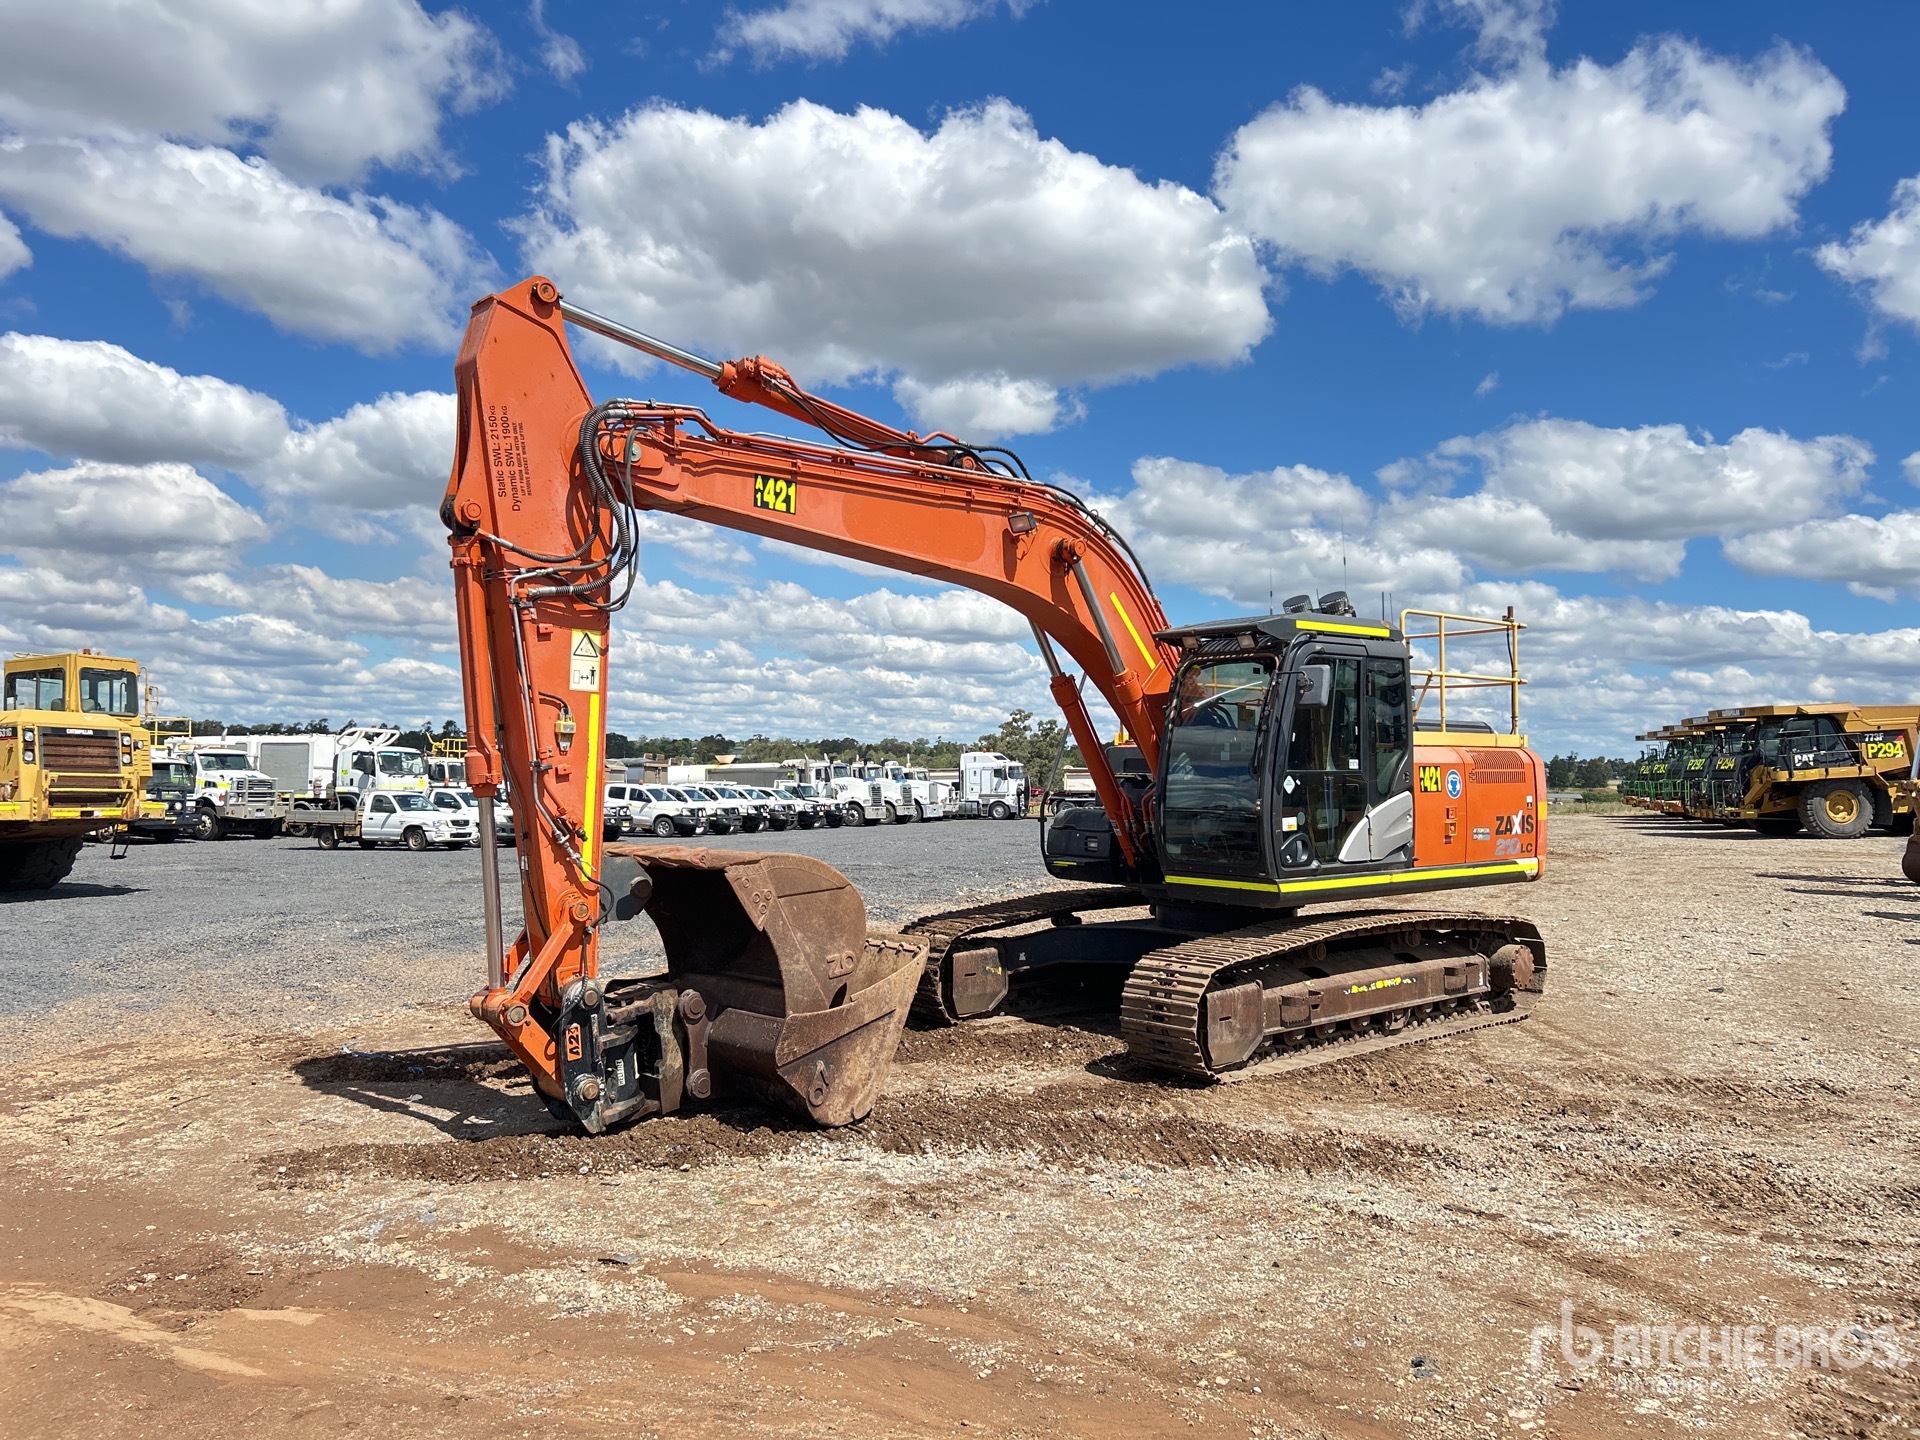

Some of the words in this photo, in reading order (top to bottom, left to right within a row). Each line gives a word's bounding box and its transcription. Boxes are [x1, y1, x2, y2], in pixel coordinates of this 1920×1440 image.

[492, 442, 503, 467] SWL:
[504, 442, 515, 467] SWL:
[496, 470, 506, 497] Static
[508, 470, 522, 511] Dynamic
[1864, 732, 1884, 742] 773F
[1794, 754, 1815, 767] CAT
[1868, 743, 1902, 758] P294
[1495, 810, 1534, 835] ZAXIS
